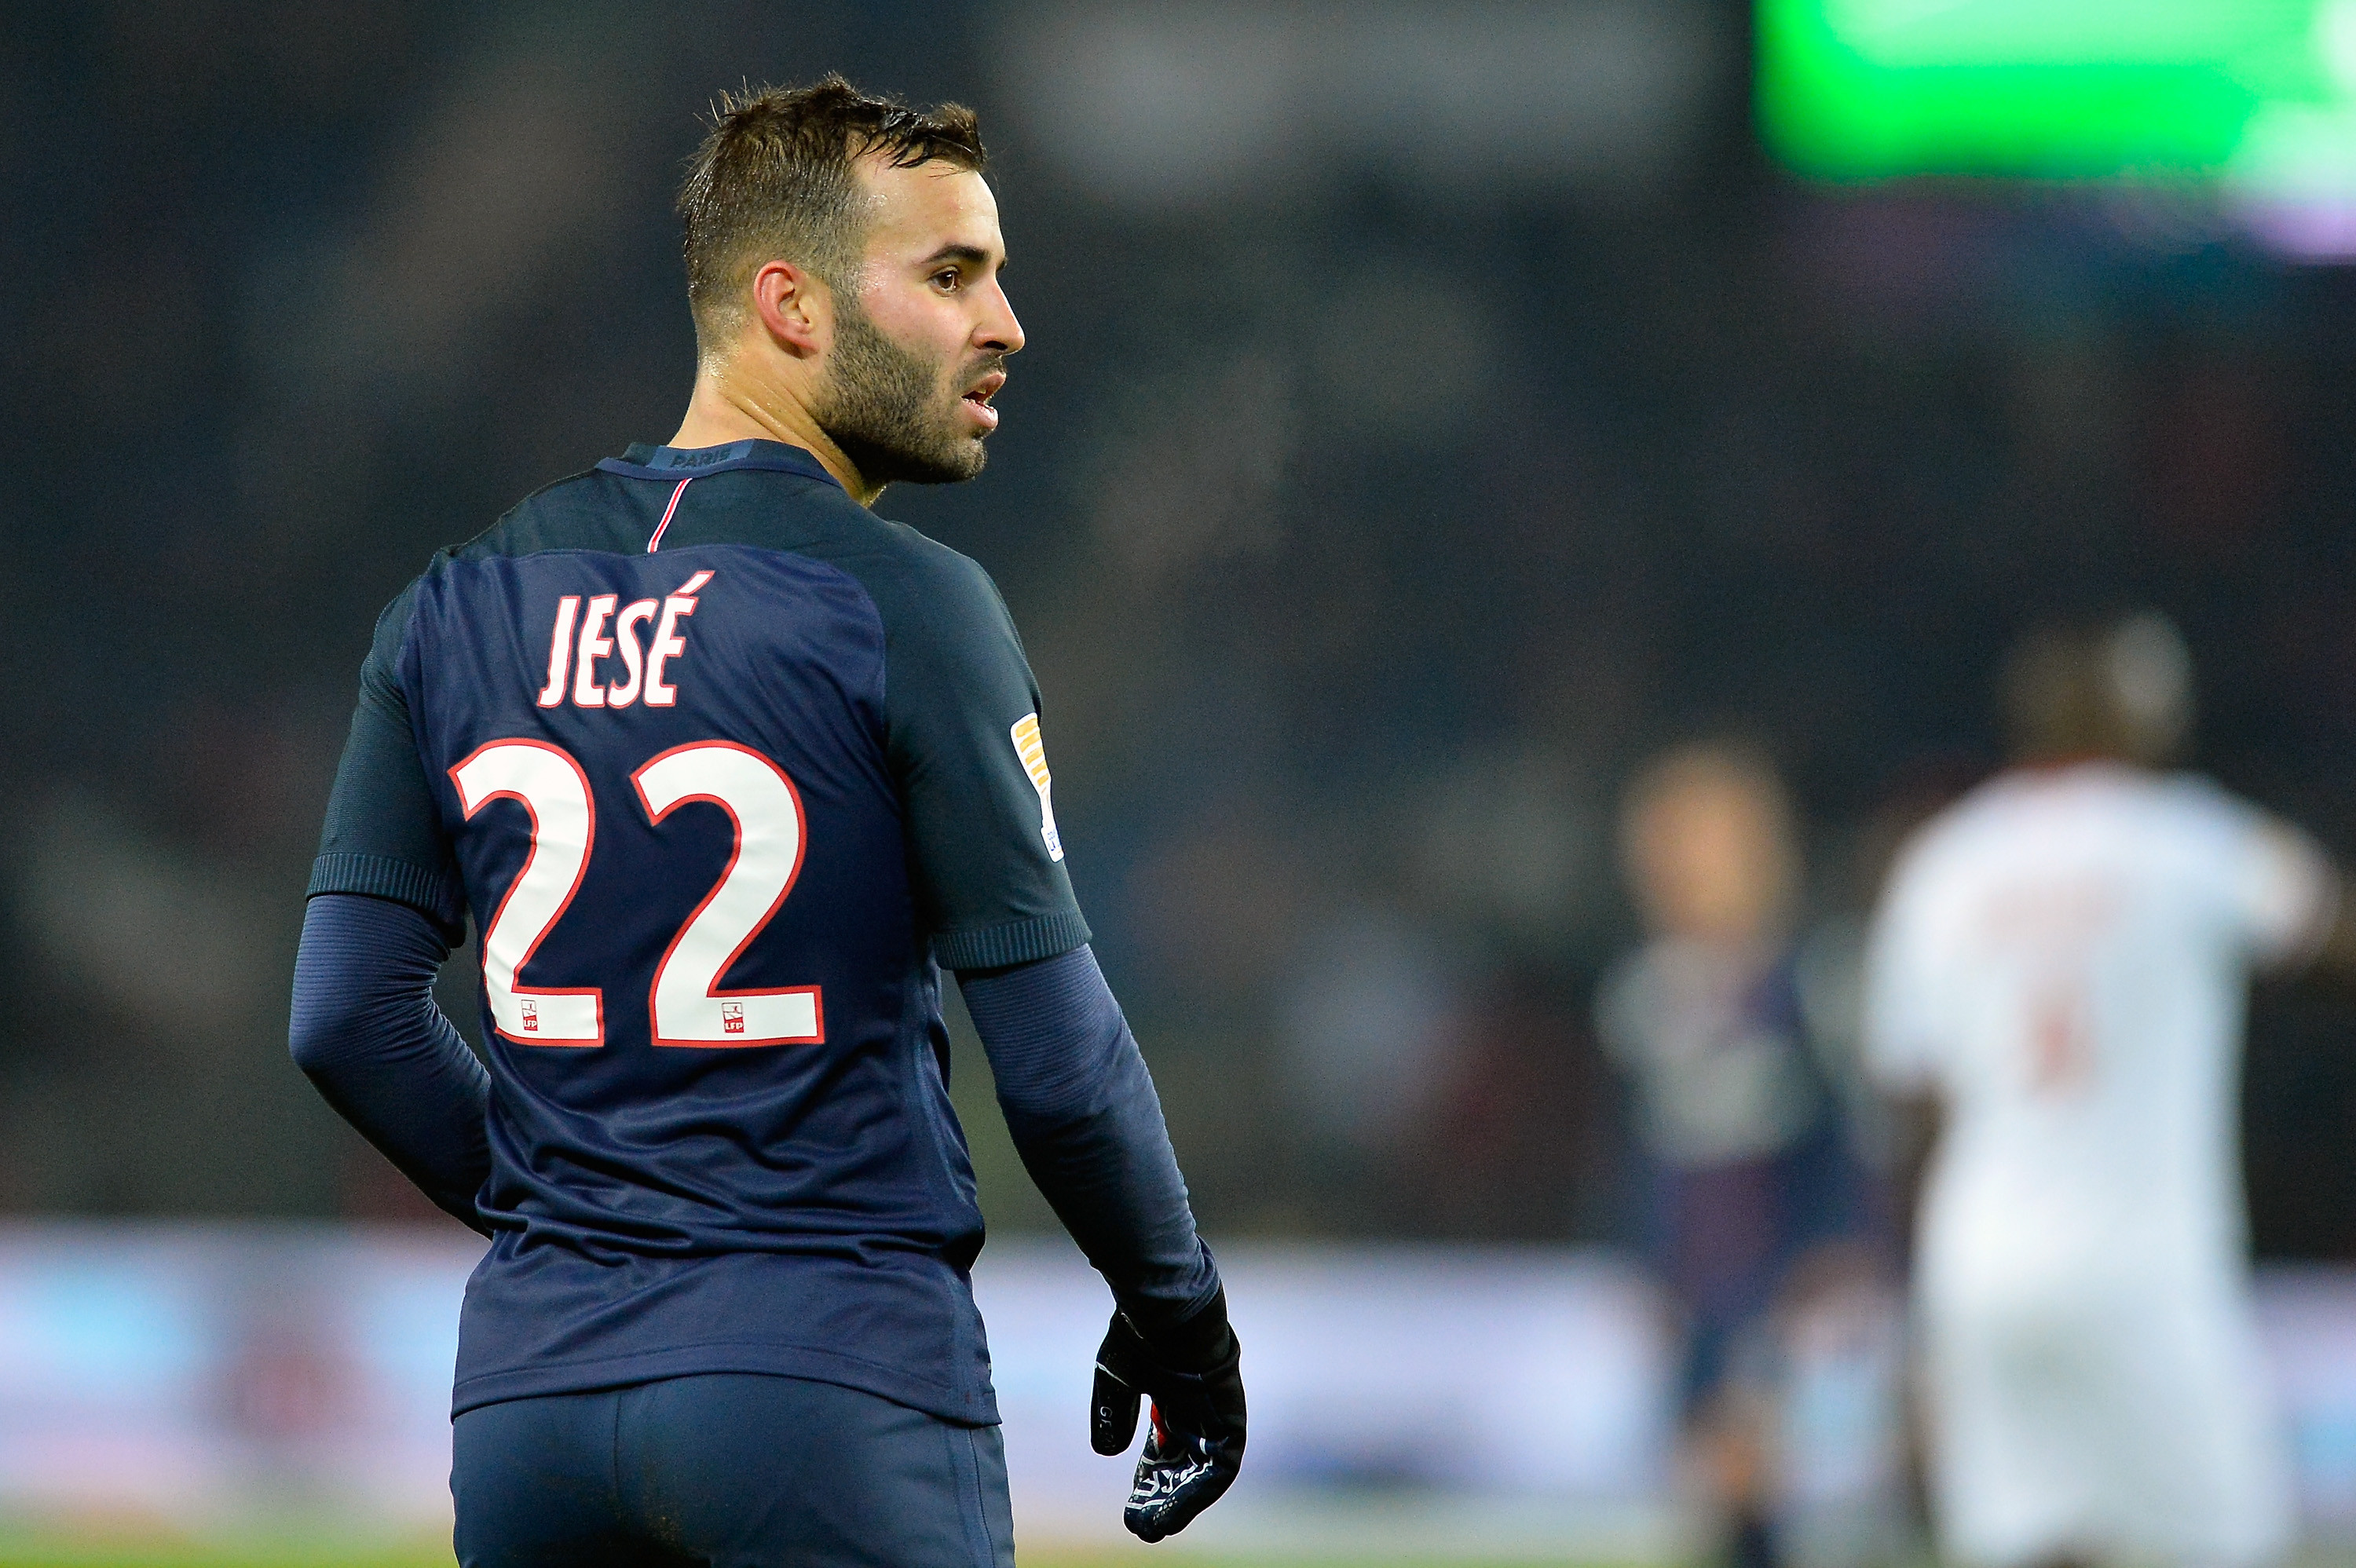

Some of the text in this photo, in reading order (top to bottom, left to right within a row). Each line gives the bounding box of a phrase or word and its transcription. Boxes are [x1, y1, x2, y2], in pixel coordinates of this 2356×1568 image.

[537, 570, 715, 708] JESÉ
[447, 737, 825, 1048] 22
[726, 1022, 743, 1030] LFP
